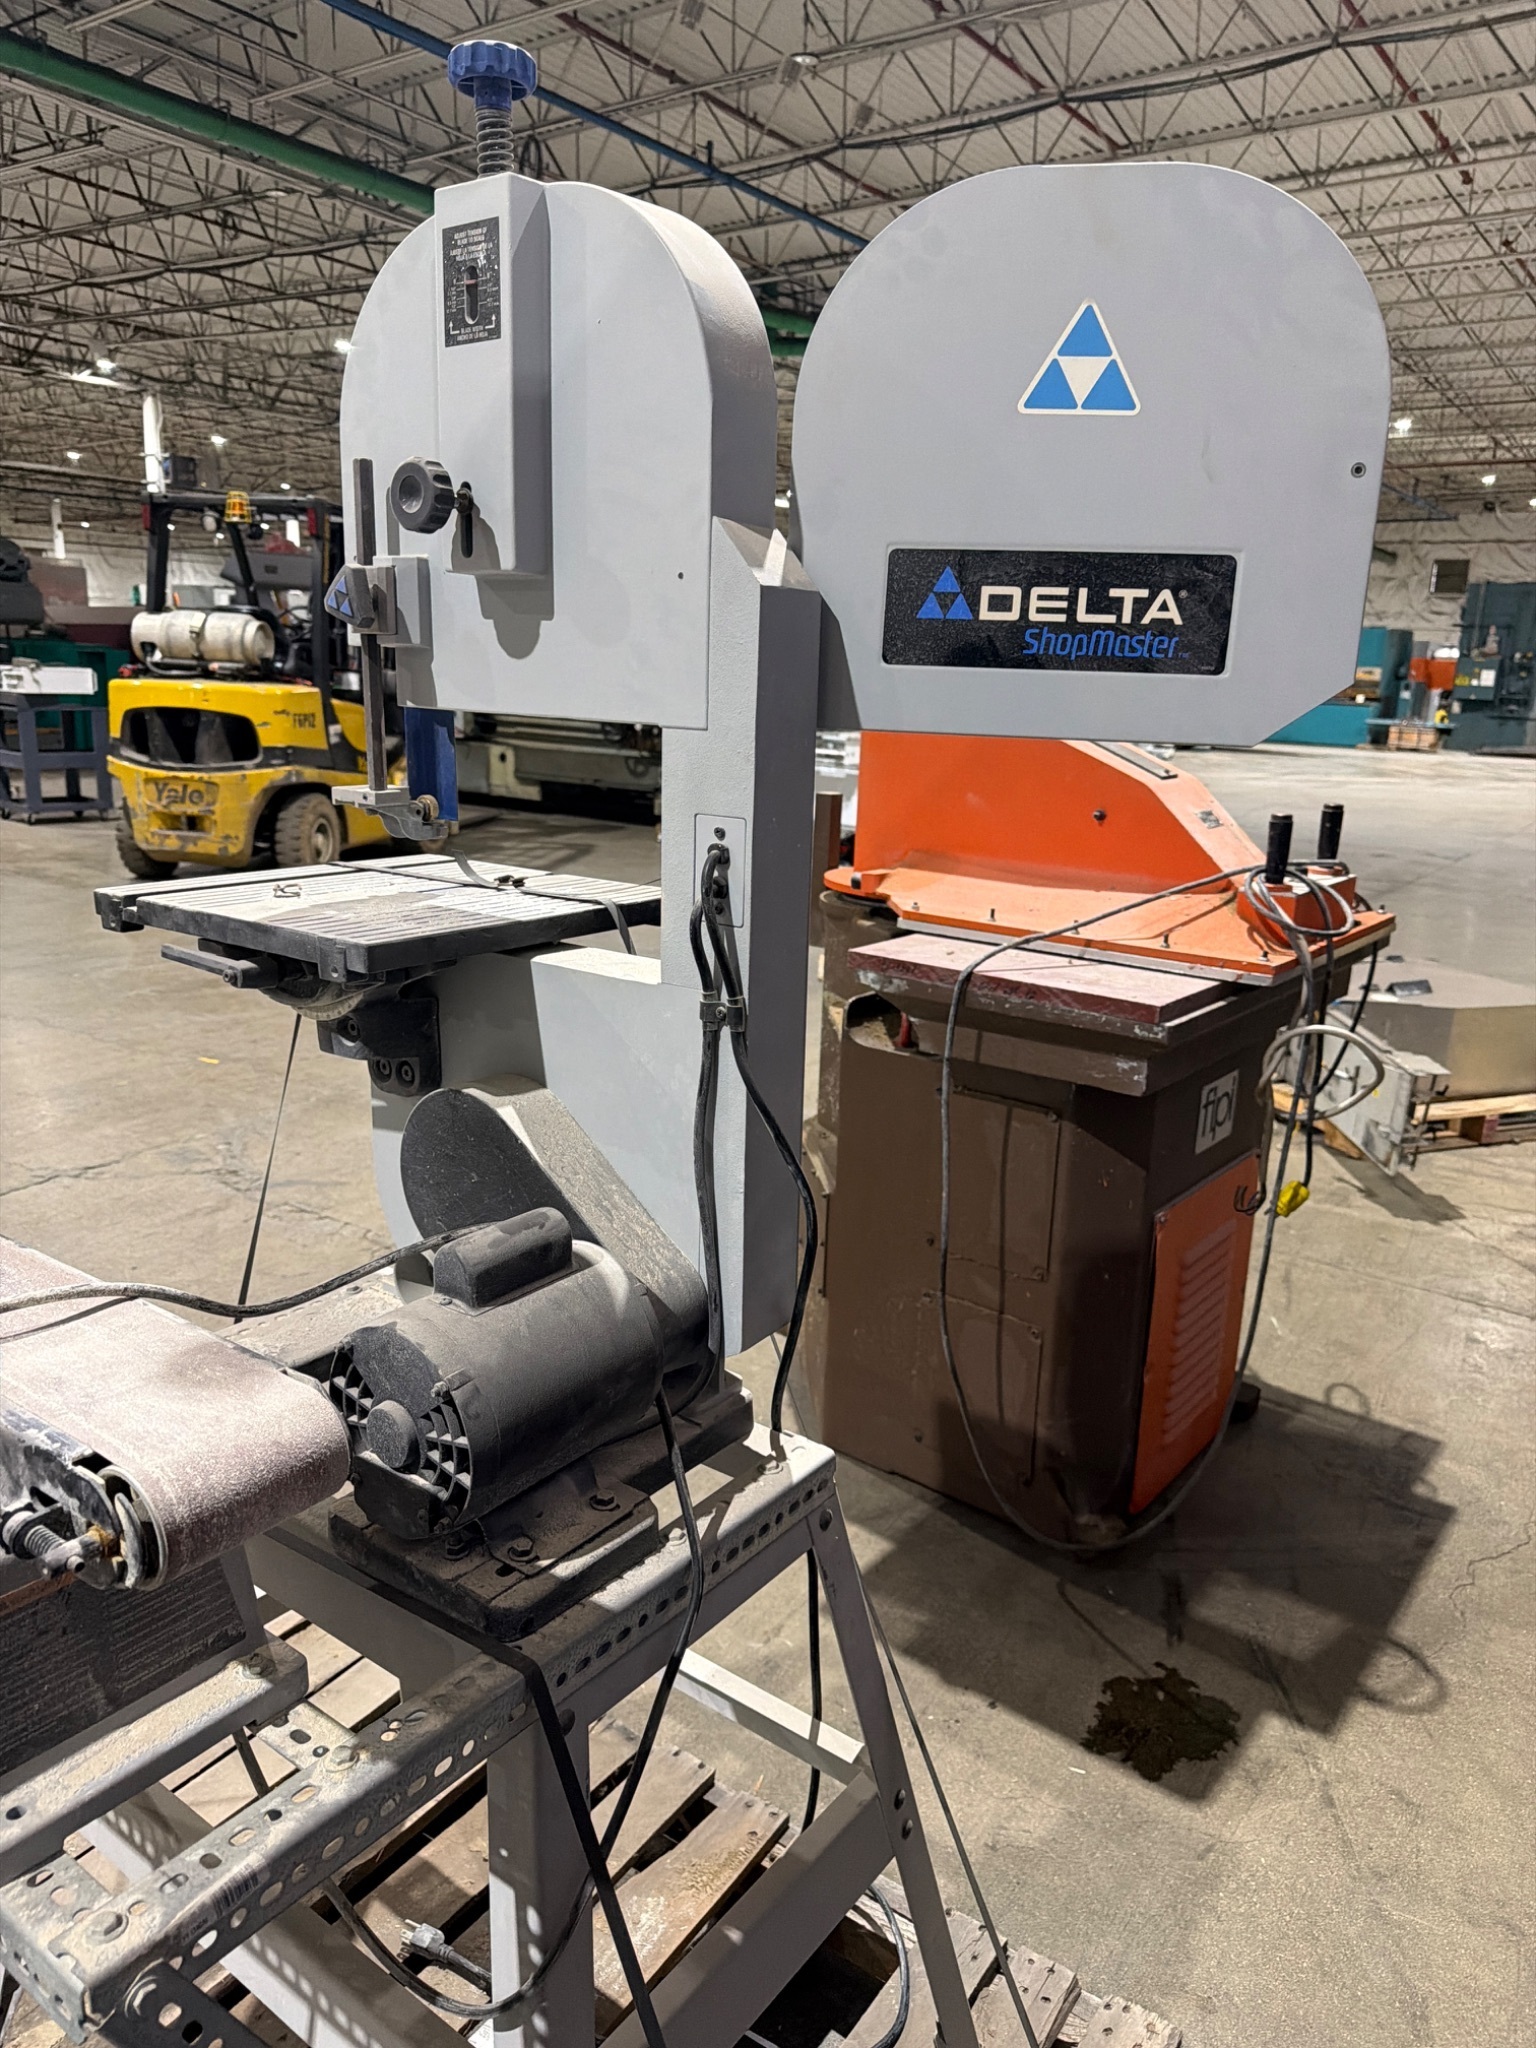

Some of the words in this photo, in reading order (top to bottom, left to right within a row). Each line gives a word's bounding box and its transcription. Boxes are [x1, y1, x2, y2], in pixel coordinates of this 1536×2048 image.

[979, 585, 1183, 625] DELTA
[1022, 627, 1180, 660] ShopMaster
[154, 781, 204, 805] Yale
